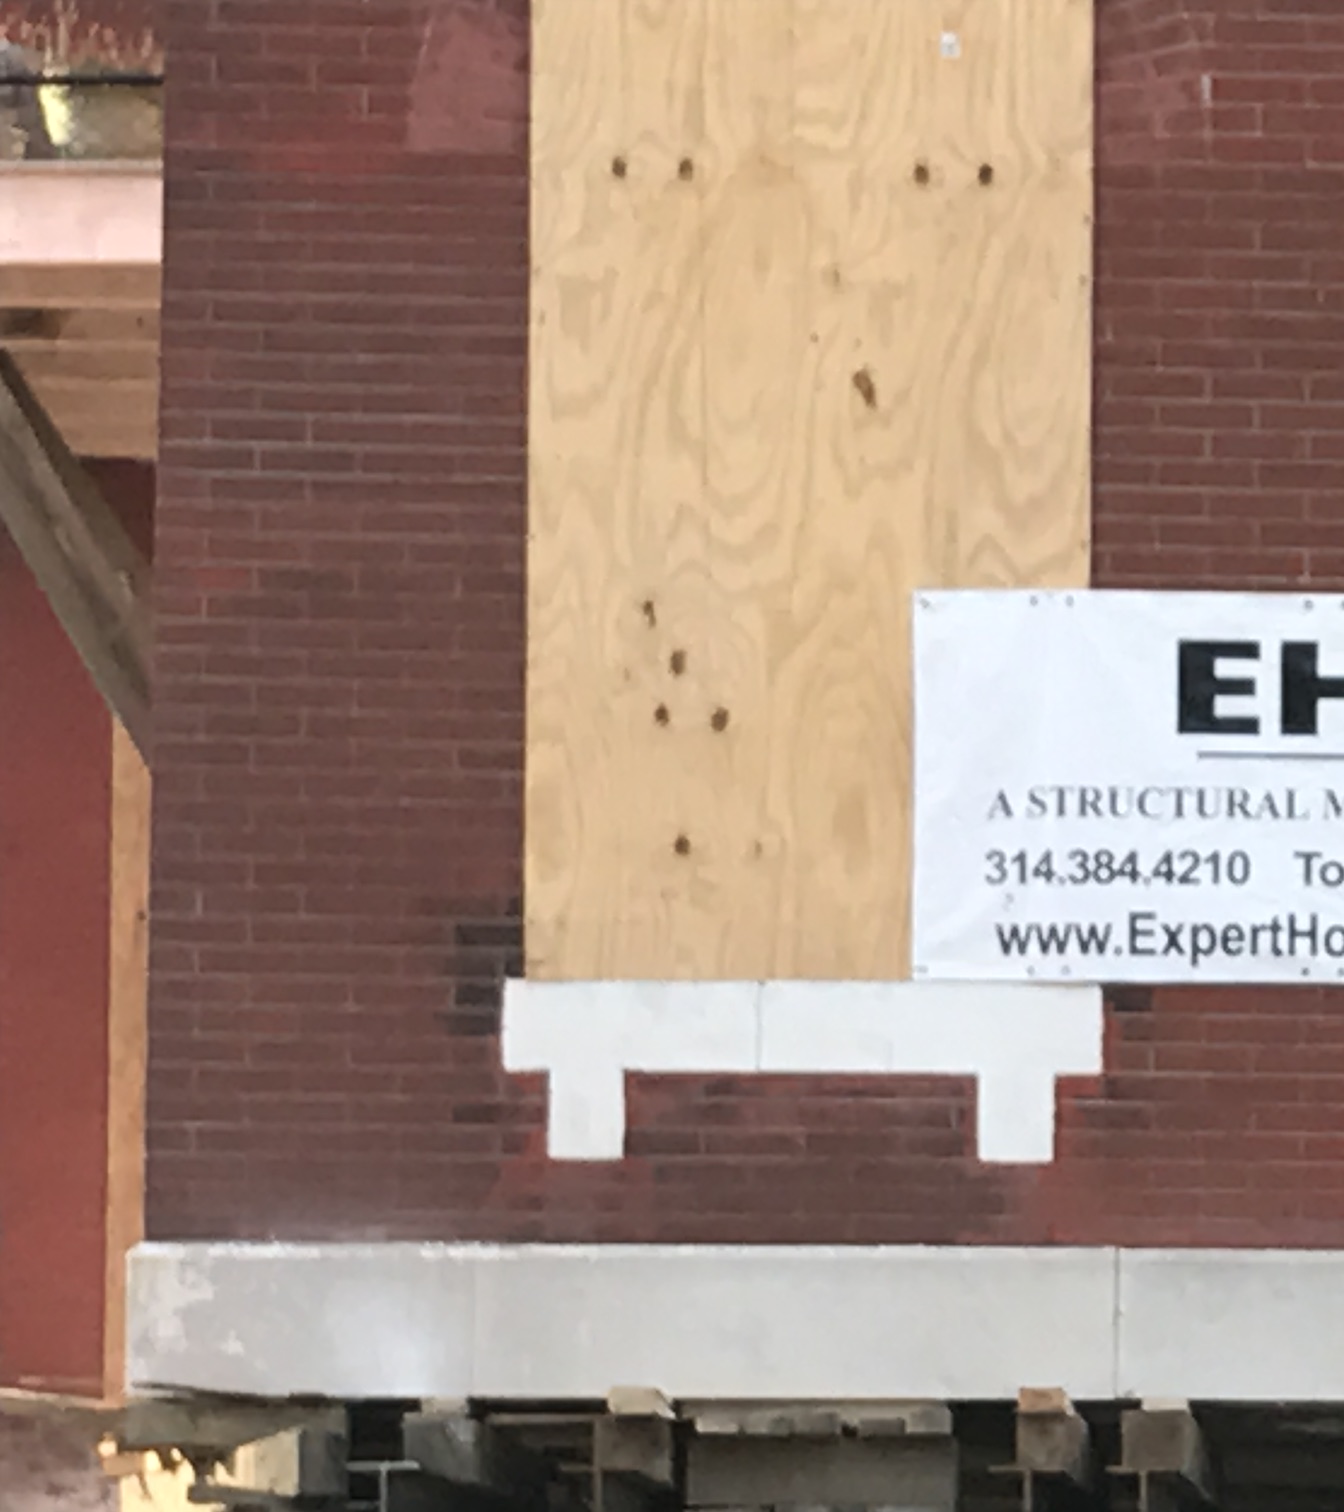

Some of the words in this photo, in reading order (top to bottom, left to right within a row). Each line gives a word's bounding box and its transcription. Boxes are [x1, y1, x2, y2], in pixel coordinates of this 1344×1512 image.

[987, 787, 1015, 819] A
[1026, 785, 1311, 822] STRUCTURAL
[985, 848, 1252, 887] 314.384.4210
